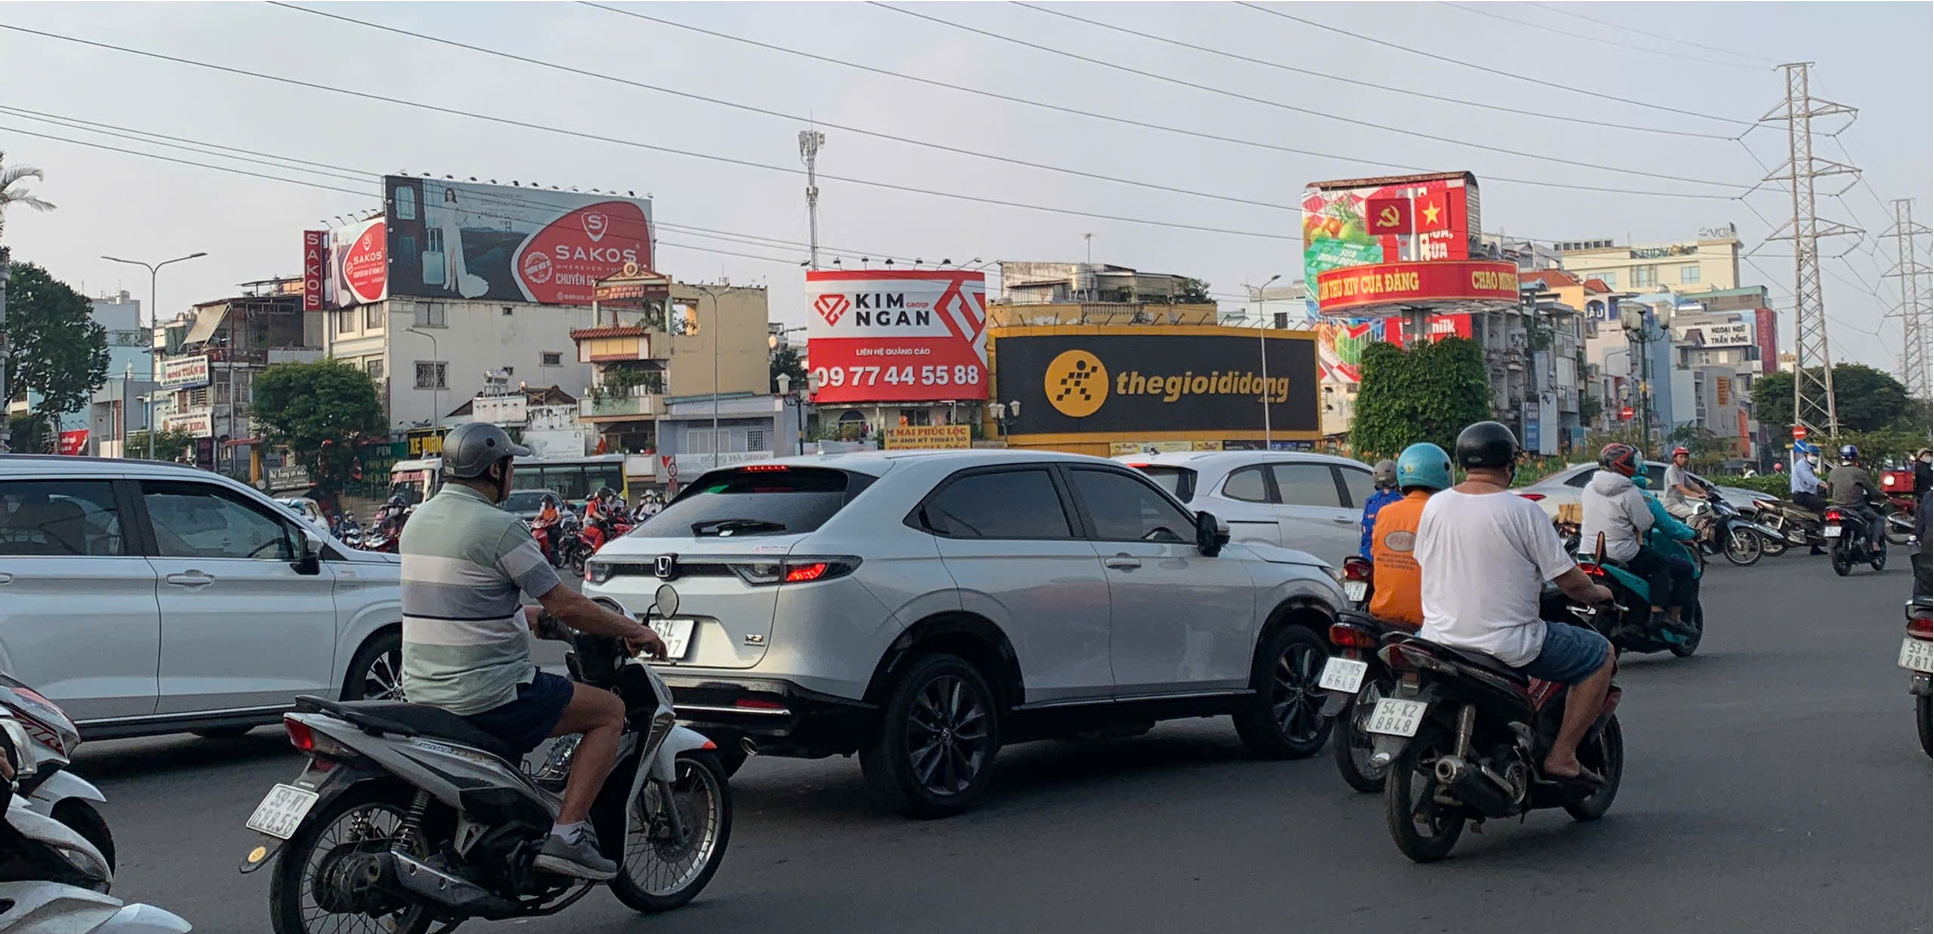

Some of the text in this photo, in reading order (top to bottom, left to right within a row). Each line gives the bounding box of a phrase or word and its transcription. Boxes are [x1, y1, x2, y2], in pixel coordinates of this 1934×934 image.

[353, 250, 383, 266] SAKOS
[555, 244, 637, 264] SAKOS
[306, 233, 320, 307] SAKOS
[555, 272, 586, 285] CHUYÊN
[1472, 267, 1498, 290] CHÀO
[1343, 276, 1359, 296] XIV
[1384, 268, 1420, 292] ĐẢNG
[856, 293, 904, 309] KIM
[856, 311, 930, 326] NGAN
[856, 345, 931, 357] LIÊN HỆ QUẢNG CÁO
[814, 364, 979, 388] 09 77 44 55 88
[1116, 370, 1289, 402] thegioididong
[896, 426, 966, 437] MAI PHÚC LỘC
[410, 437, 421, 455] XE
[1381, 701, 1418, 718] 54-K2
[1375, 716, 1412, 733] 8848
